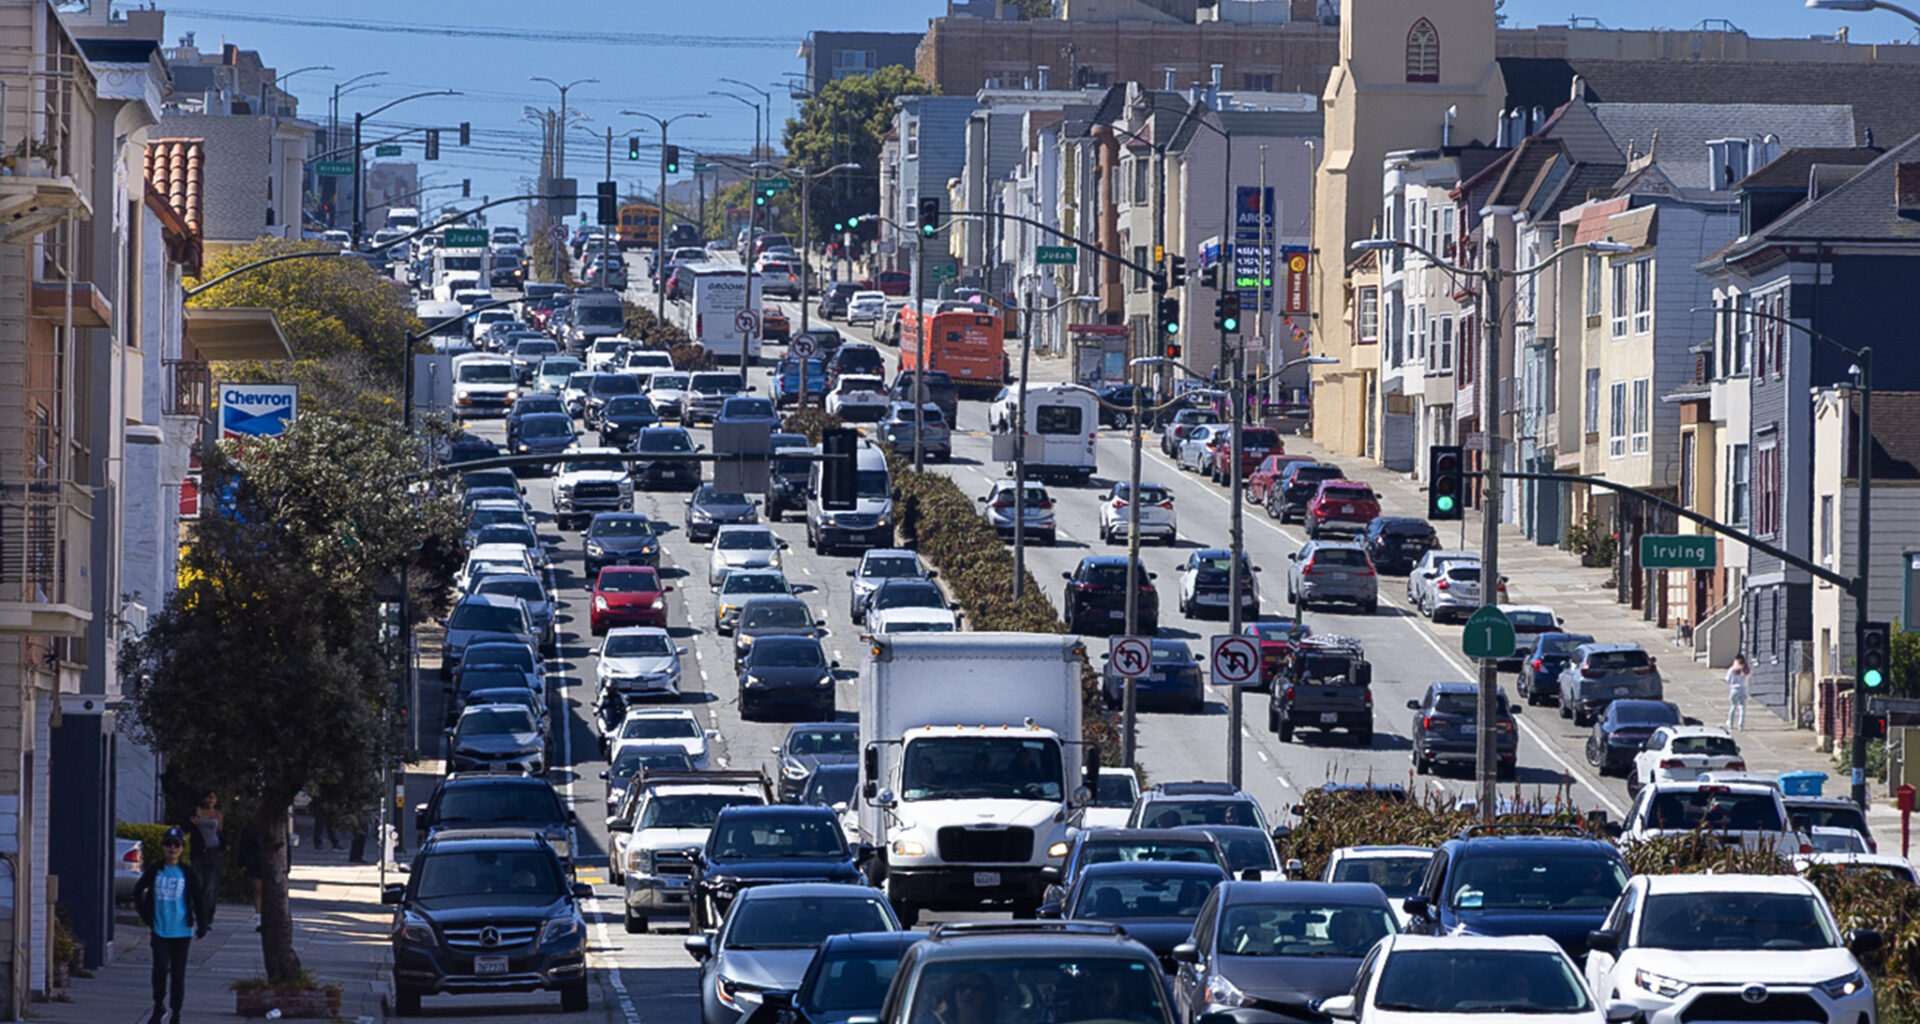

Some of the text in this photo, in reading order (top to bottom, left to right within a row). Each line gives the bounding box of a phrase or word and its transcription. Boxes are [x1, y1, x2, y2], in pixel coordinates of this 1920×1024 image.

[450, 233, 483, 242] Judah
[1042, 251, 1072, 259] Judah
[224, 389, 292, 406] Chevron
[1653, 545, 1705, 562] Irving
[1485, 626, 1492, 652] 1
